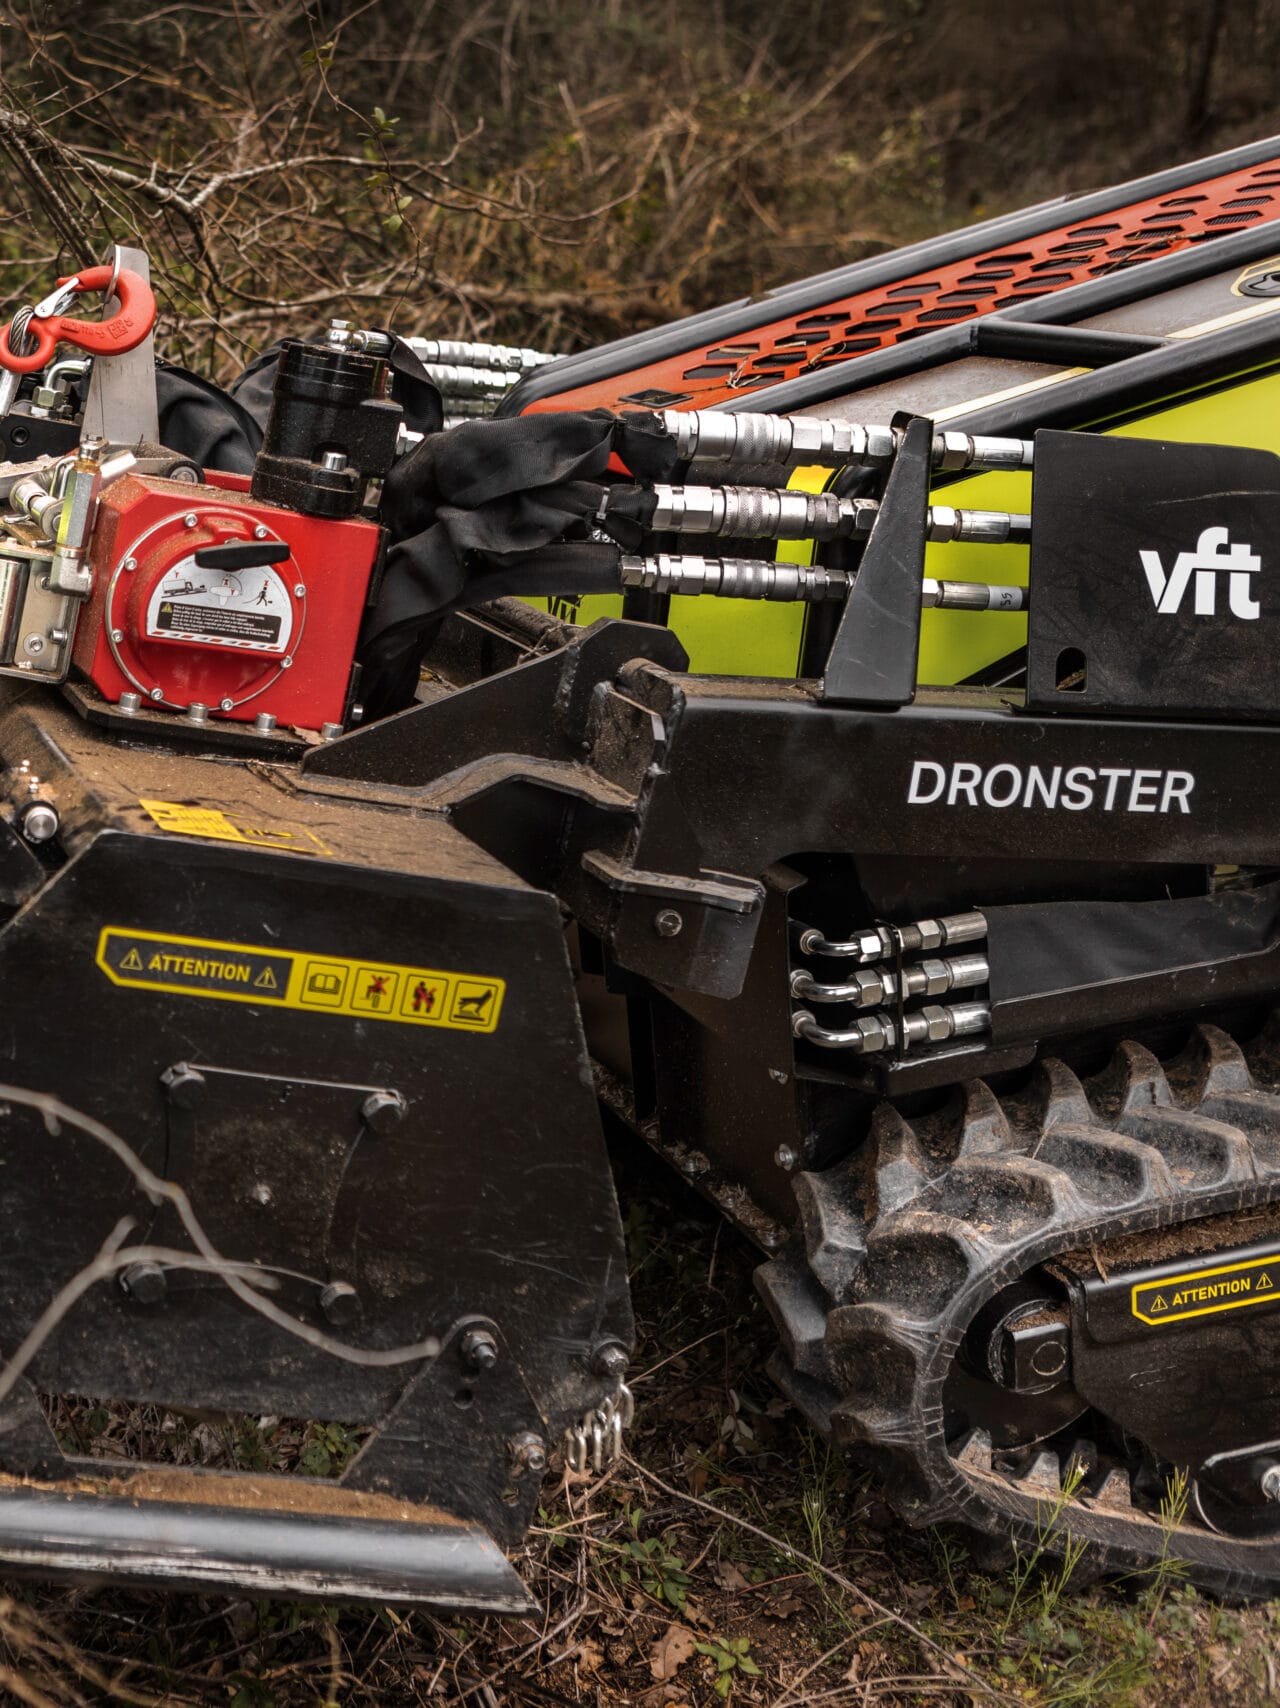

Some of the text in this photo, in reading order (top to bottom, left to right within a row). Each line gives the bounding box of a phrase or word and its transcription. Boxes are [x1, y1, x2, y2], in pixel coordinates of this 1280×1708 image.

[1139, 527, 1261, 619] vft
[907, 761, 1196, 814] DRONSTER
[148, 953, 251, 983] ATTENTION
[1172, 1277, 1251, 1307] ATTENTION
